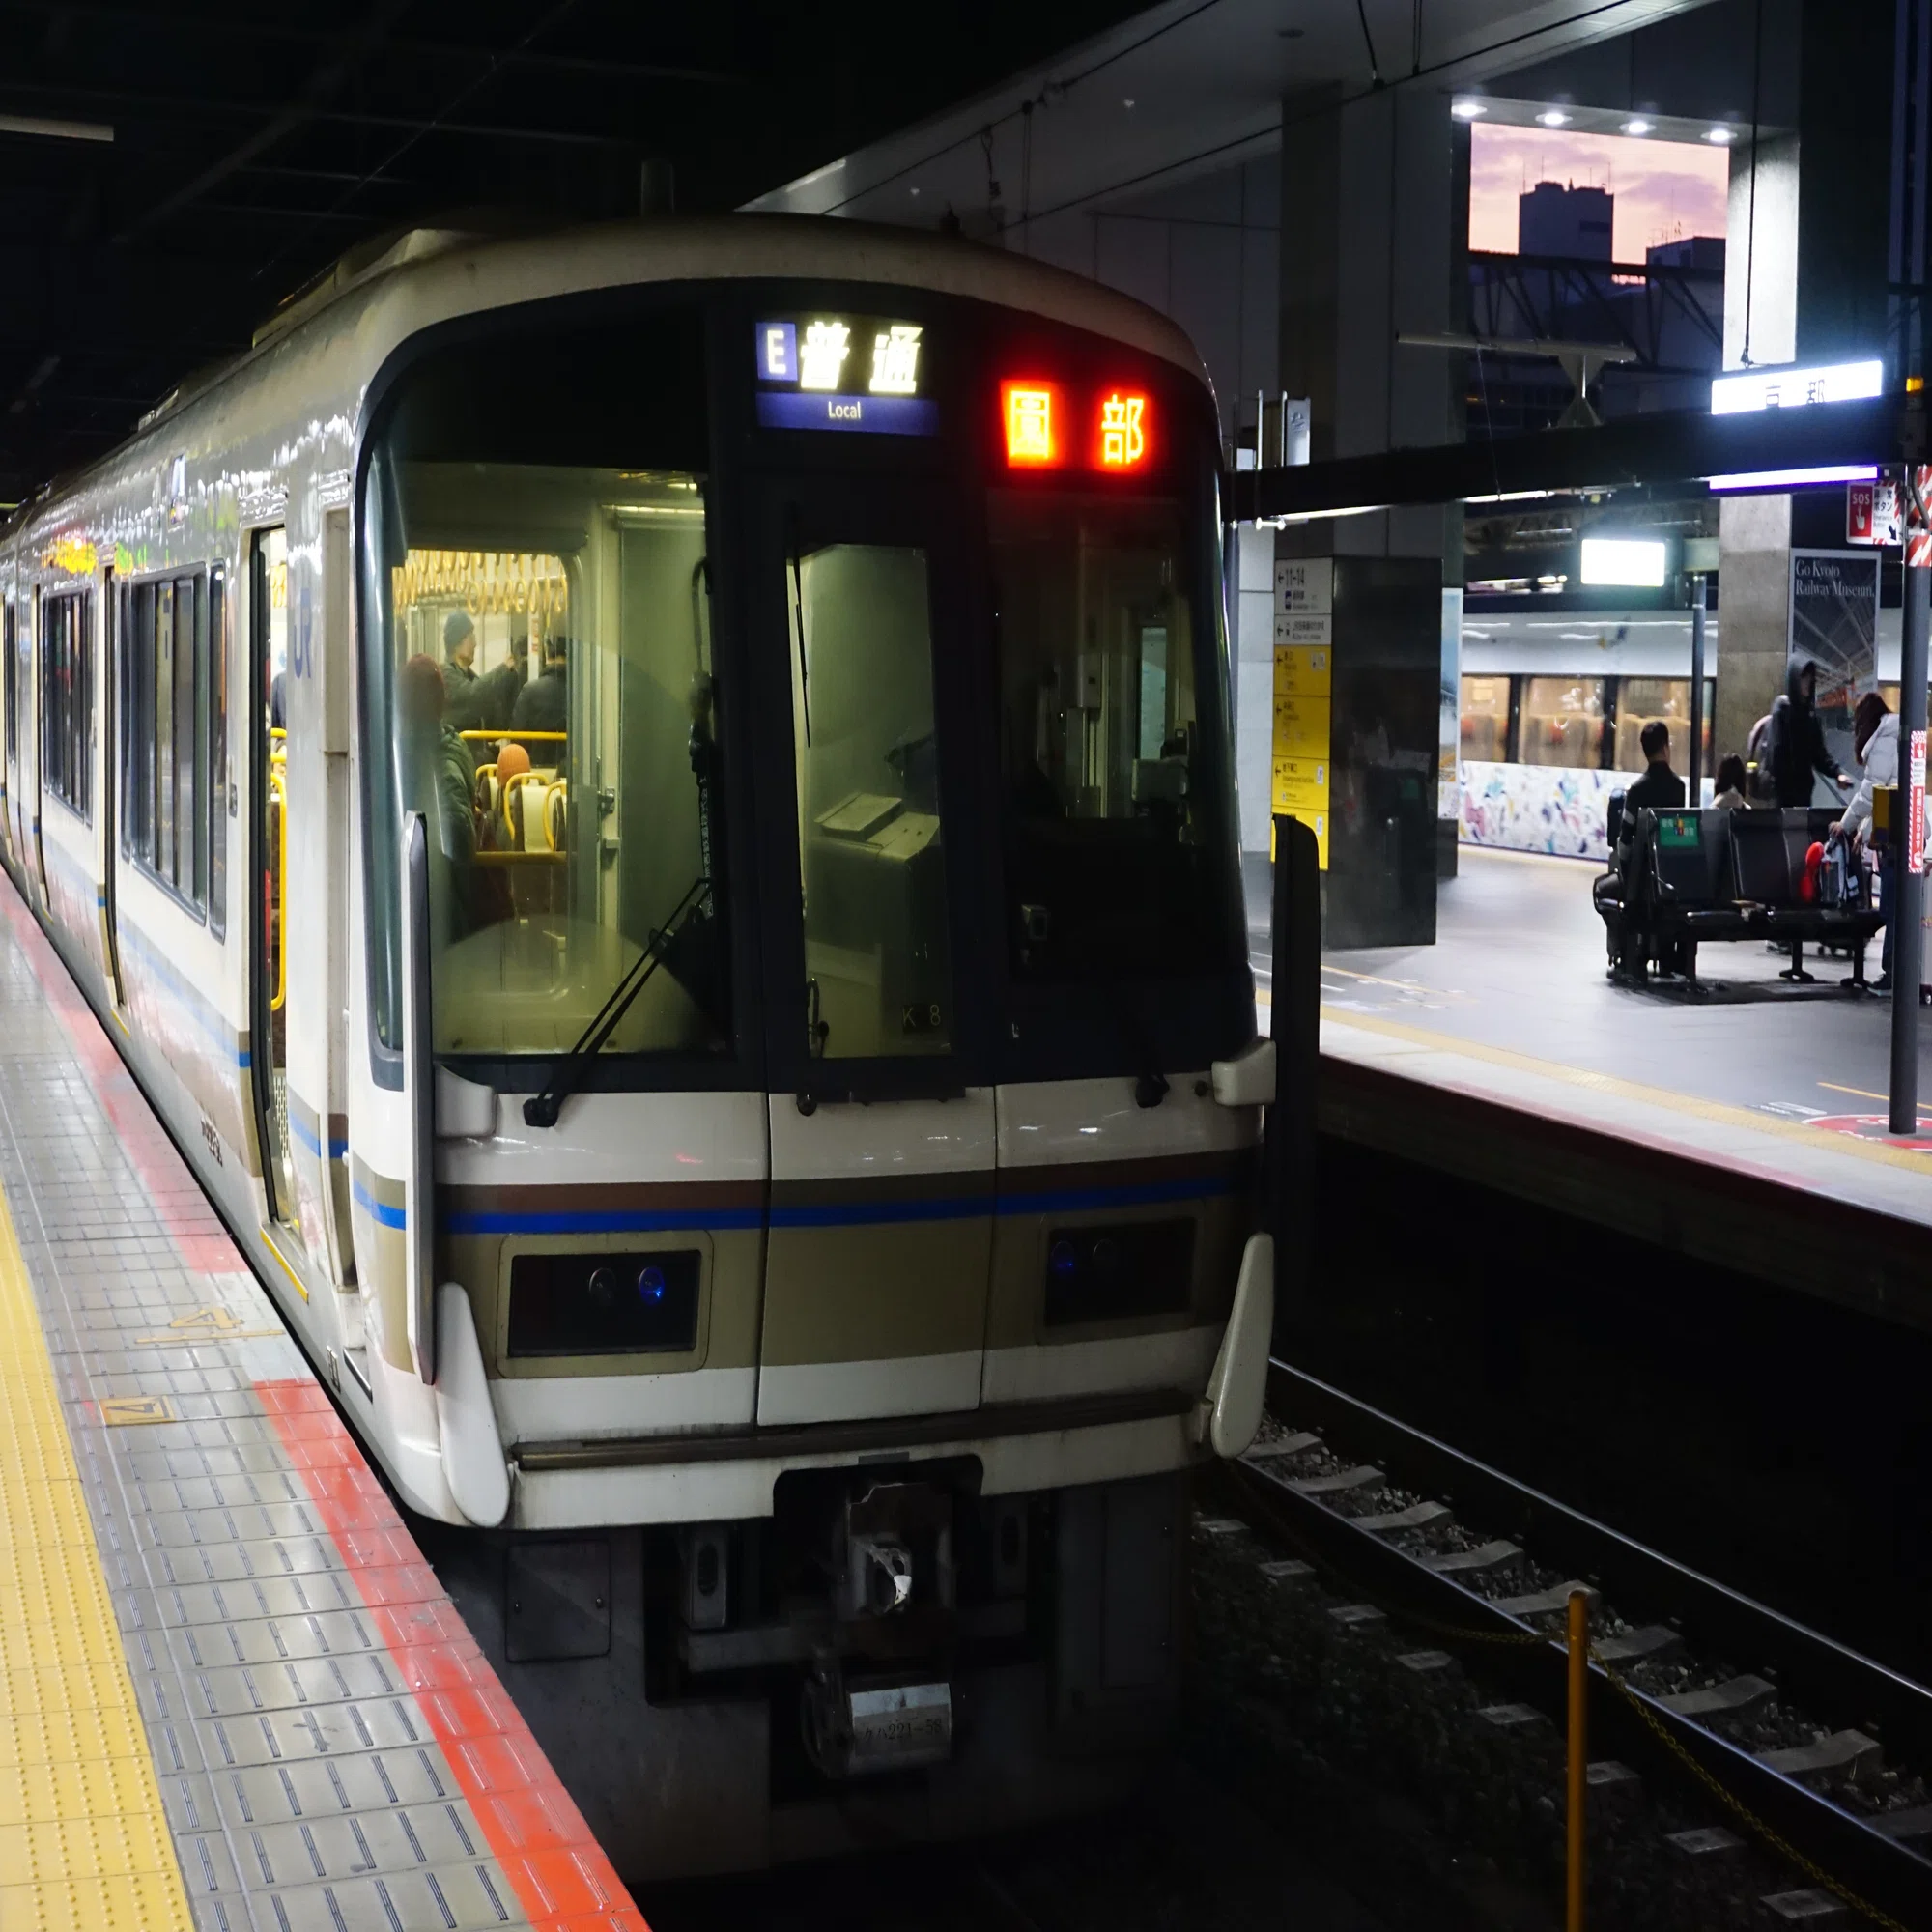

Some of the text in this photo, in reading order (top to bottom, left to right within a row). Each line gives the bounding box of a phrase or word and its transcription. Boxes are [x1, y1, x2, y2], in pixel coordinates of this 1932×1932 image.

[767, 329, 786, 374] E
[800, 321, 923, 393] 普通
[828, 401, 862, 418] Local
[1010, 390, 1145, 465] 園部
[1852, 493, 1870, 505] SOS
[1795, 559, 1840, 581] Go Kyoto
[1795, 579, 1830, 599] Railway
[902, 1004, 942, 1028] K 8
